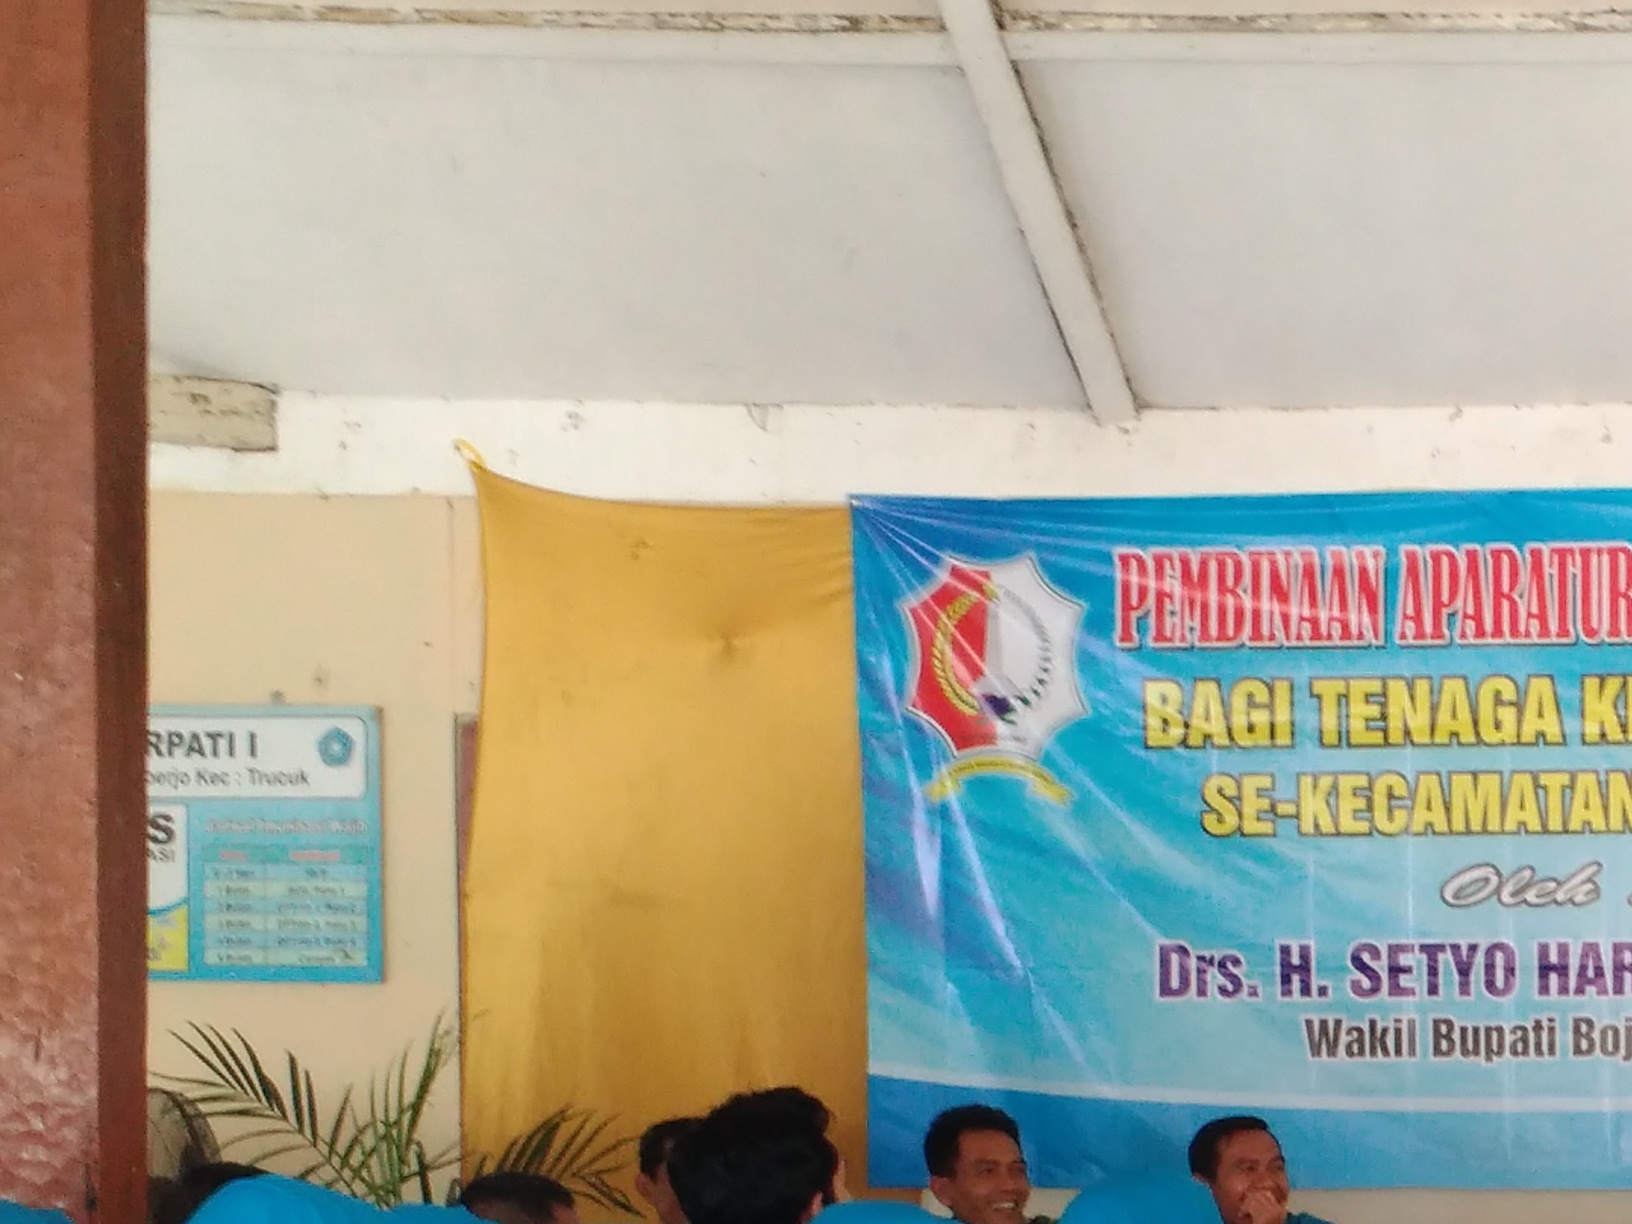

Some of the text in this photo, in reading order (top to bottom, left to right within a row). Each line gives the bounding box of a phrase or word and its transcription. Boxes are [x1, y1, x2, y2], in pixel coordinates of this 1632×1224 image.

[1114, 545, 1387, 649] PEMBINAAN
[1143, 677, 1295, 749] BAGI
[1309, 674, 1564, 747] TENAGA
[146, 729, 235, 759] RPATI
[1440, 861, 1603, 908] Oleh
[1158, 942, 1259, 999] Drs.
[1278, 942, 1329, 998] H.
[1348, 941, 1517, 998] SETYO
[1305, 1016, 1417, 1061] Wakil
[1431, 1016, 1557, 1062] Bupati
